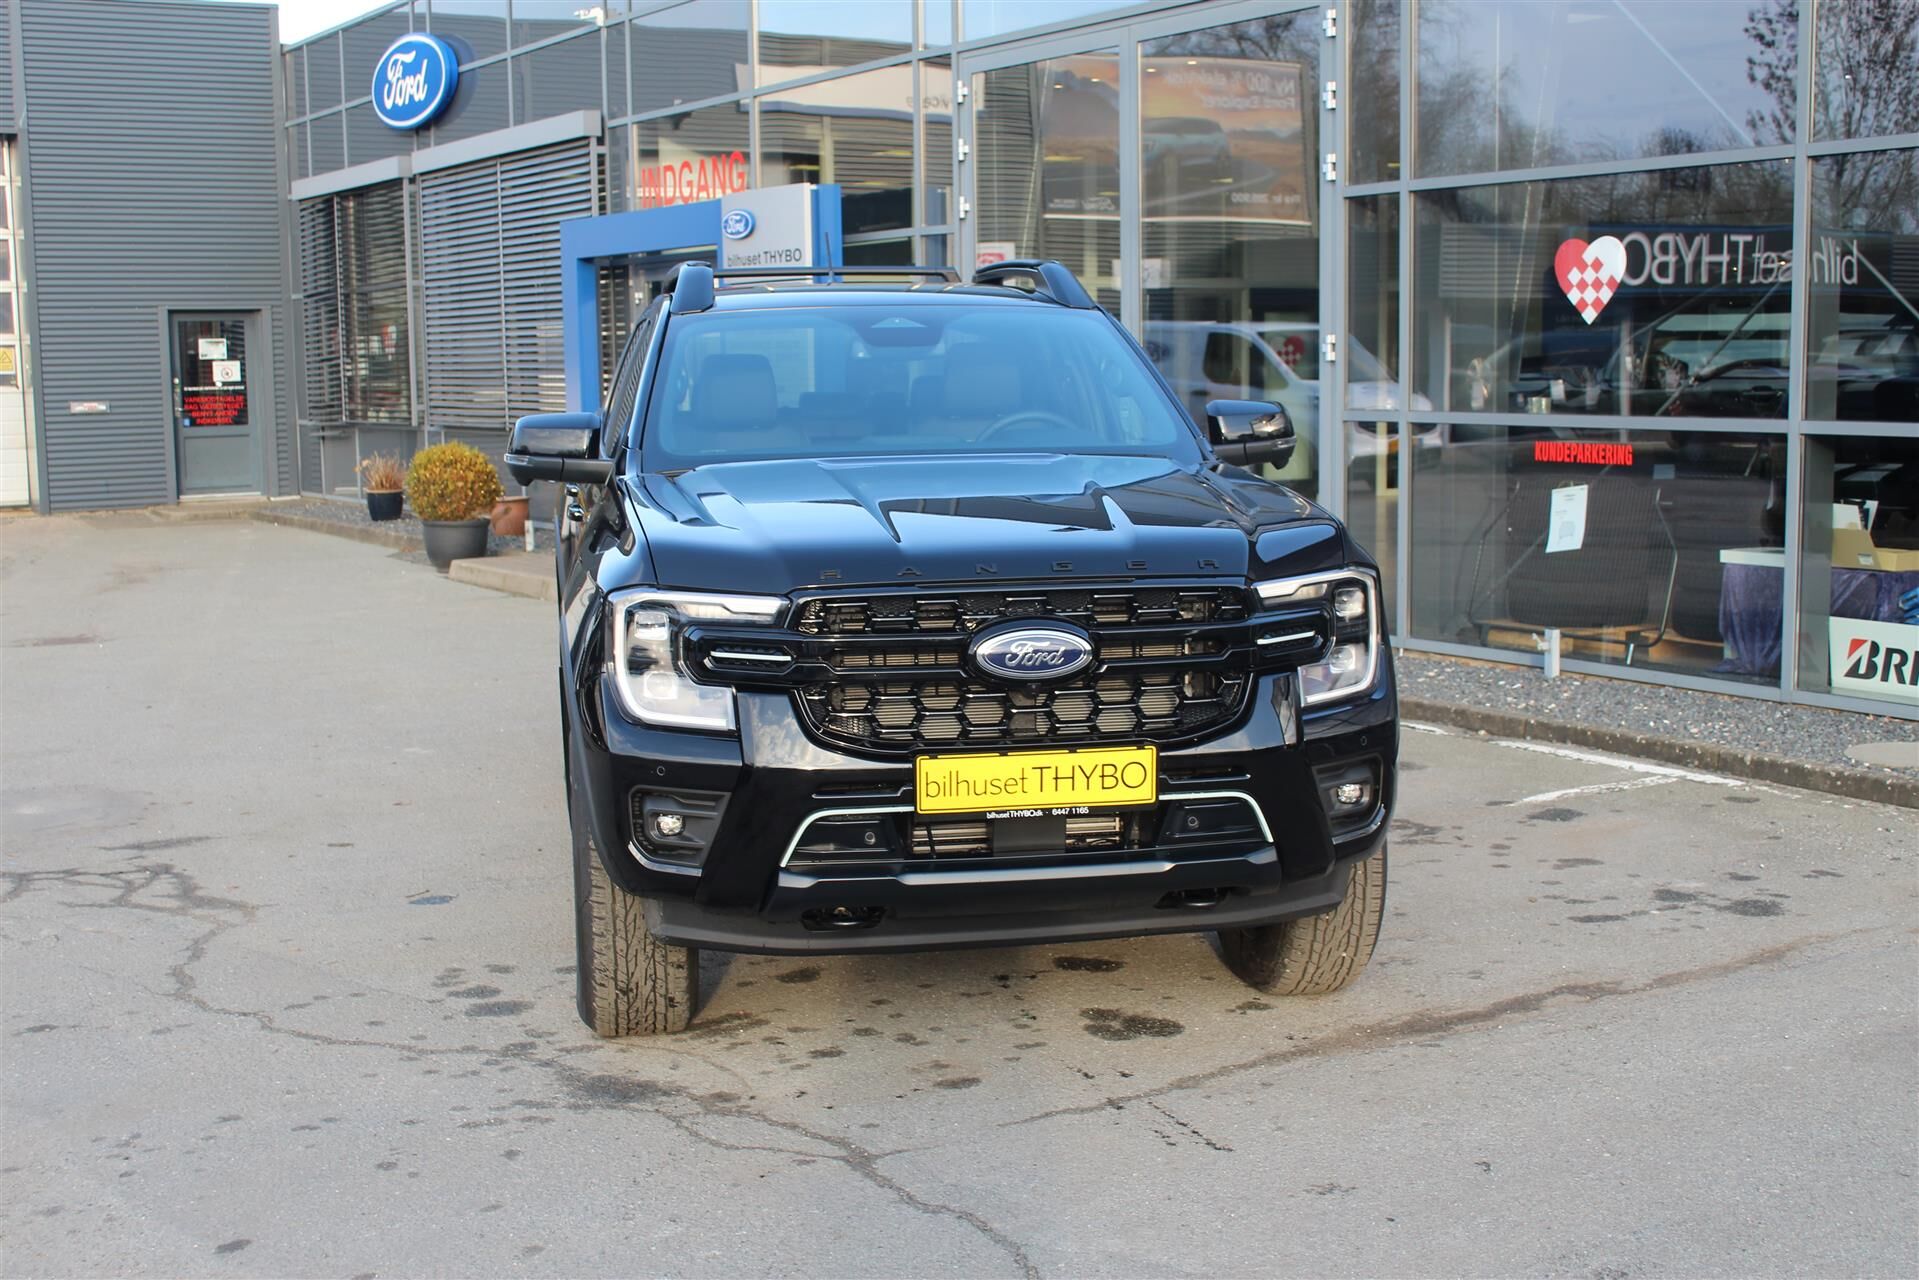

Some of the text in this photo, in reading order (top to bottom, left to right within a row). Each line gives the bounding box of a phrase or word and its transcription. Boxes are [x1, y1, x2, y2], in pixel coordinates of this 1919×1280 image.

[384, 50, 428, 110] Ford
[641, 150, 747, 209] INDGANG
[727, 248, 803, 267] bilhuset THYBO
[1535, 441, 1633, 467] KUNDEPARKERING
[820, 559, 1221, 580] RANGER
[1005, 640, 1066, 667] Ford
[1052, 808, 1070, 816] 6447
[1071, 806, 1090, 815] 1165
